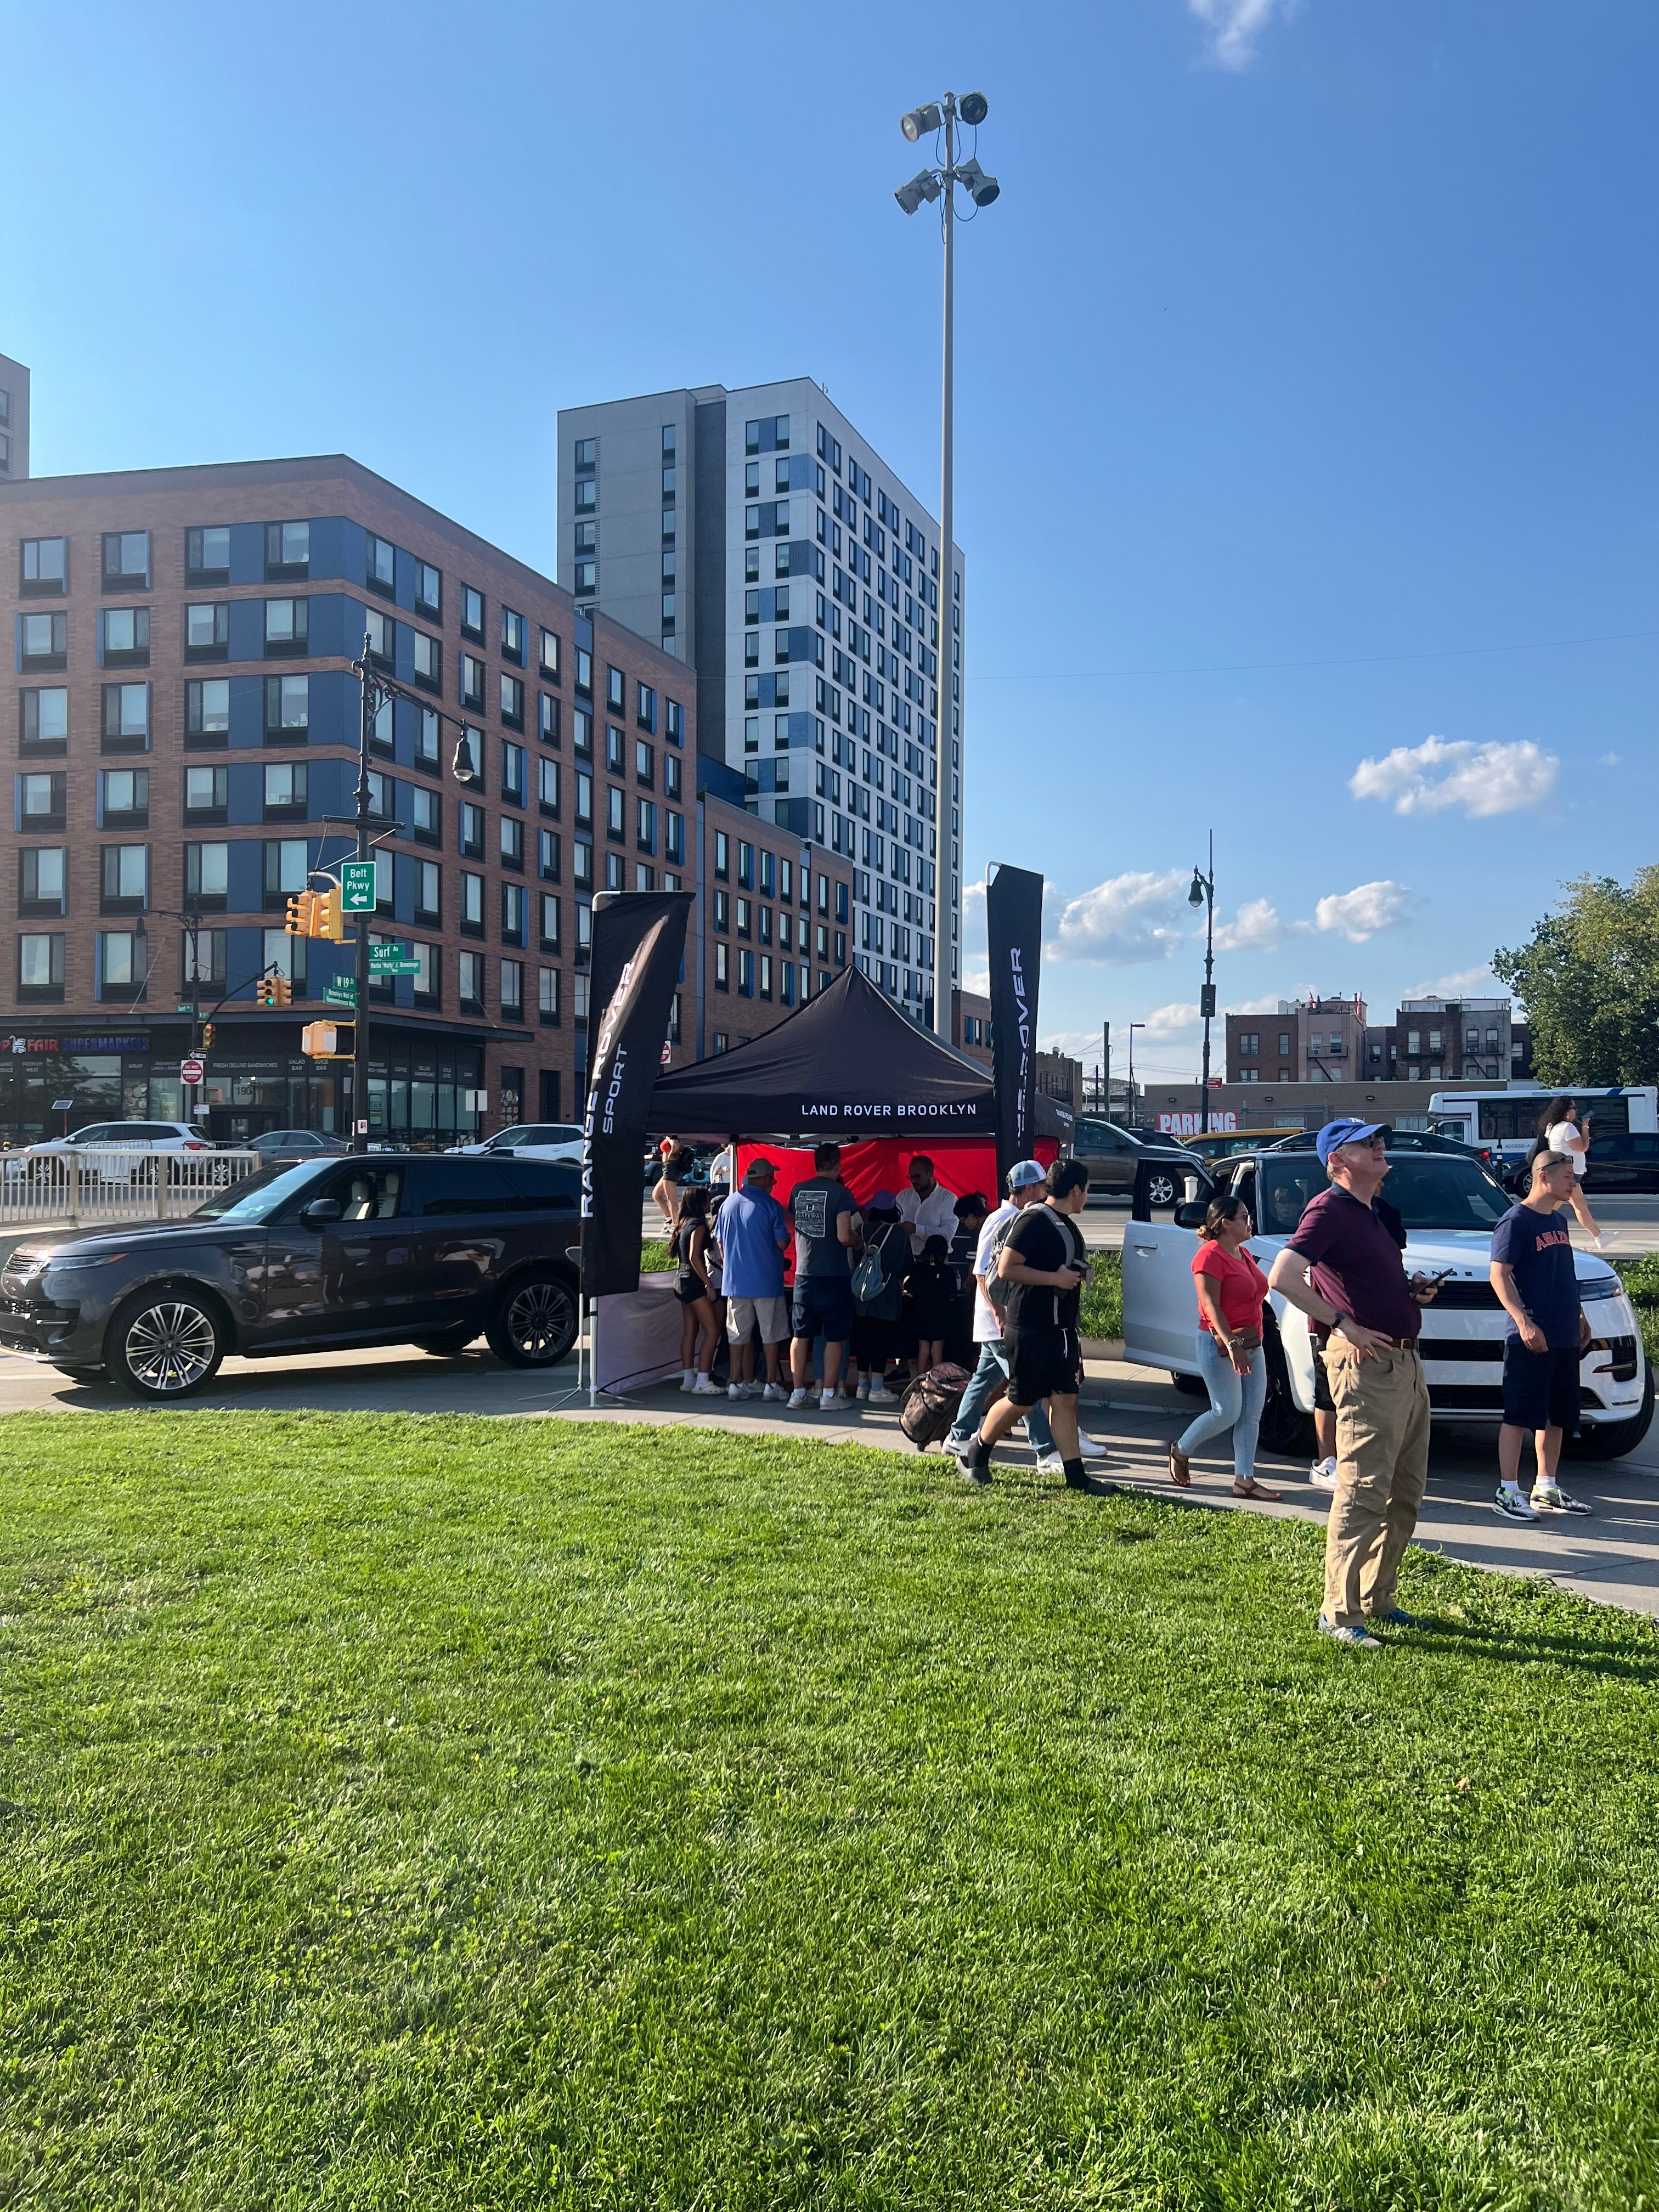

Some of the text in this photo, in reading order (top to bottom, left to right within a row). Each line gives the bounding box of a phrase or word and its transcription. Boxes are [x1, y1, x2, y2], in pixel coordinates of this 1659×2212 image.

[350, 868, 367, 878] Belt
[347, 881, 370, 891] Pkwy
[374, 946, 390, 958] Surf
[337, 975, 342, 987] W
[343, 977, 349, 988] 19
[592, 961, 635, 1080] ROVER
[27, 1039, 59, 1052] FAIR
[63, 1037, 150, 1052] SUPERMARKETS
[236, 1086, 251, 1096] 190
[602, 1043, 628, 1135] SPORT
[802, 1104, 977, 1116] LAND ROVER BROOKLYN
[1160, 1111, 1236, 1136] PARKING
